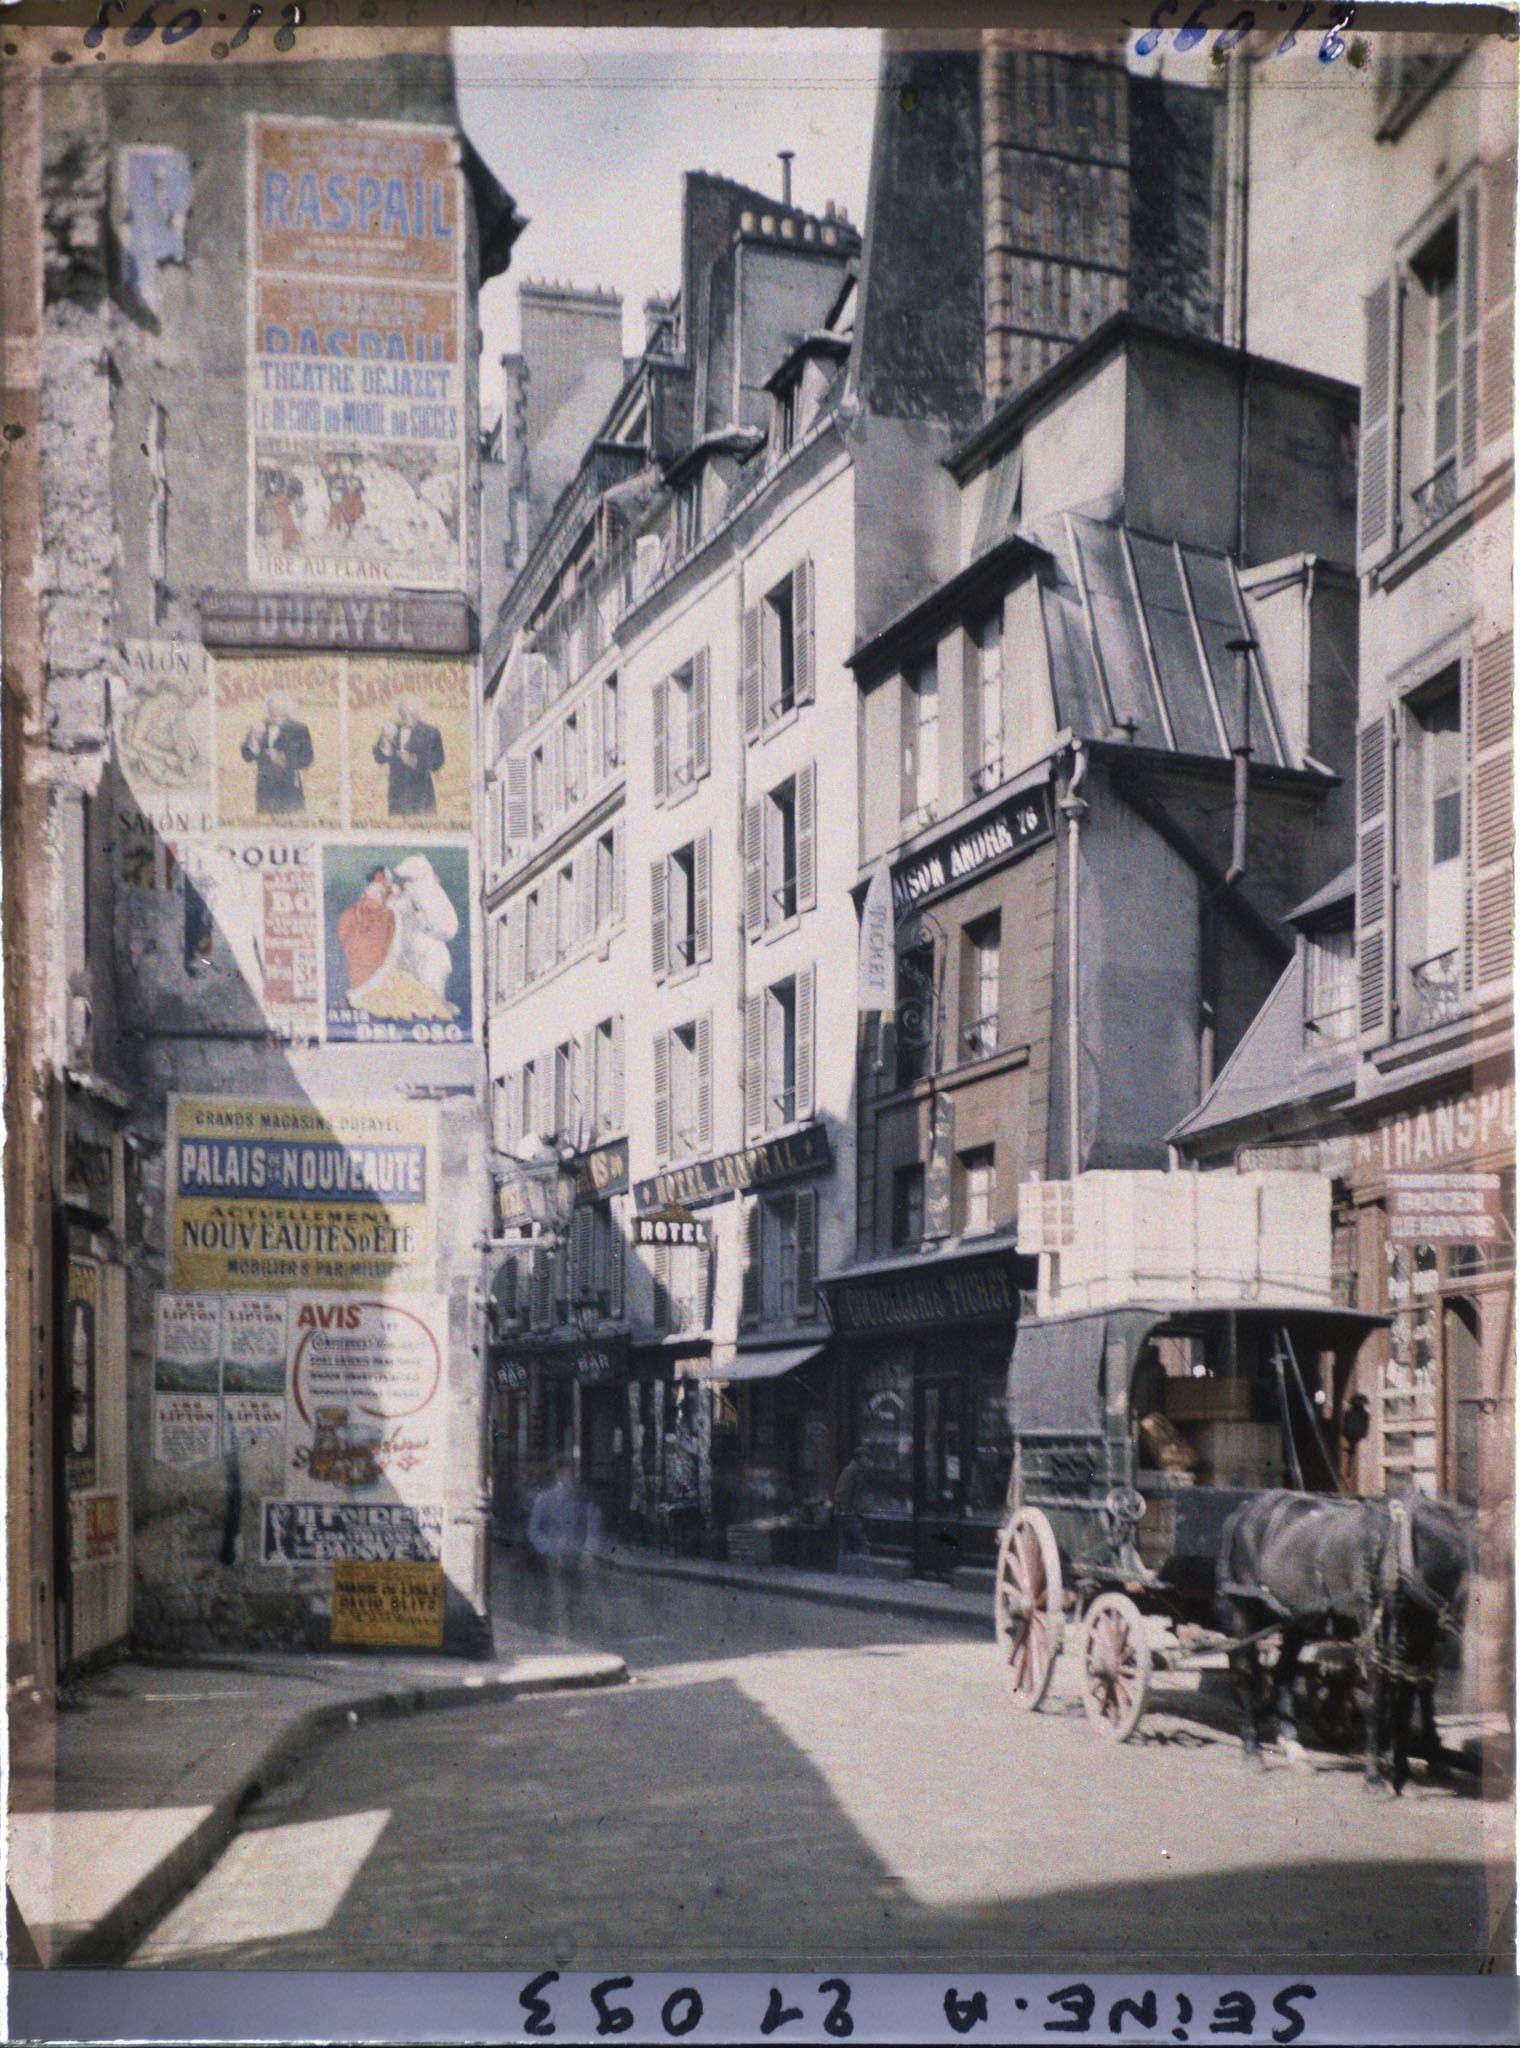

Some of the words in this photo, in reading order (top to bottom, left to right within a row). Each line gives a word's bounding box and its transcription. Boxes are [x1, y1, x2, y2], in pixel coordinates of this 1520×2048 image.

[263, 170, 454, 238] RASPAIL
[258, 600, 413, 642] DUFAYEL
[355, 1023, 403, 1042] DEL
[412, 1022, 463, 1043] OSO
[195, 1110, 254, 1127] GRANDS
[259, 1113, 333, 1131] MAGASINS
[183, 1144, 267, 1189] PALAIS
[210, 1205, 392, 1224] ACTUELLEMENT
[639, 1222, 708, 1244] HOTEL
[297, 1302, 361, 1329] AVIS
